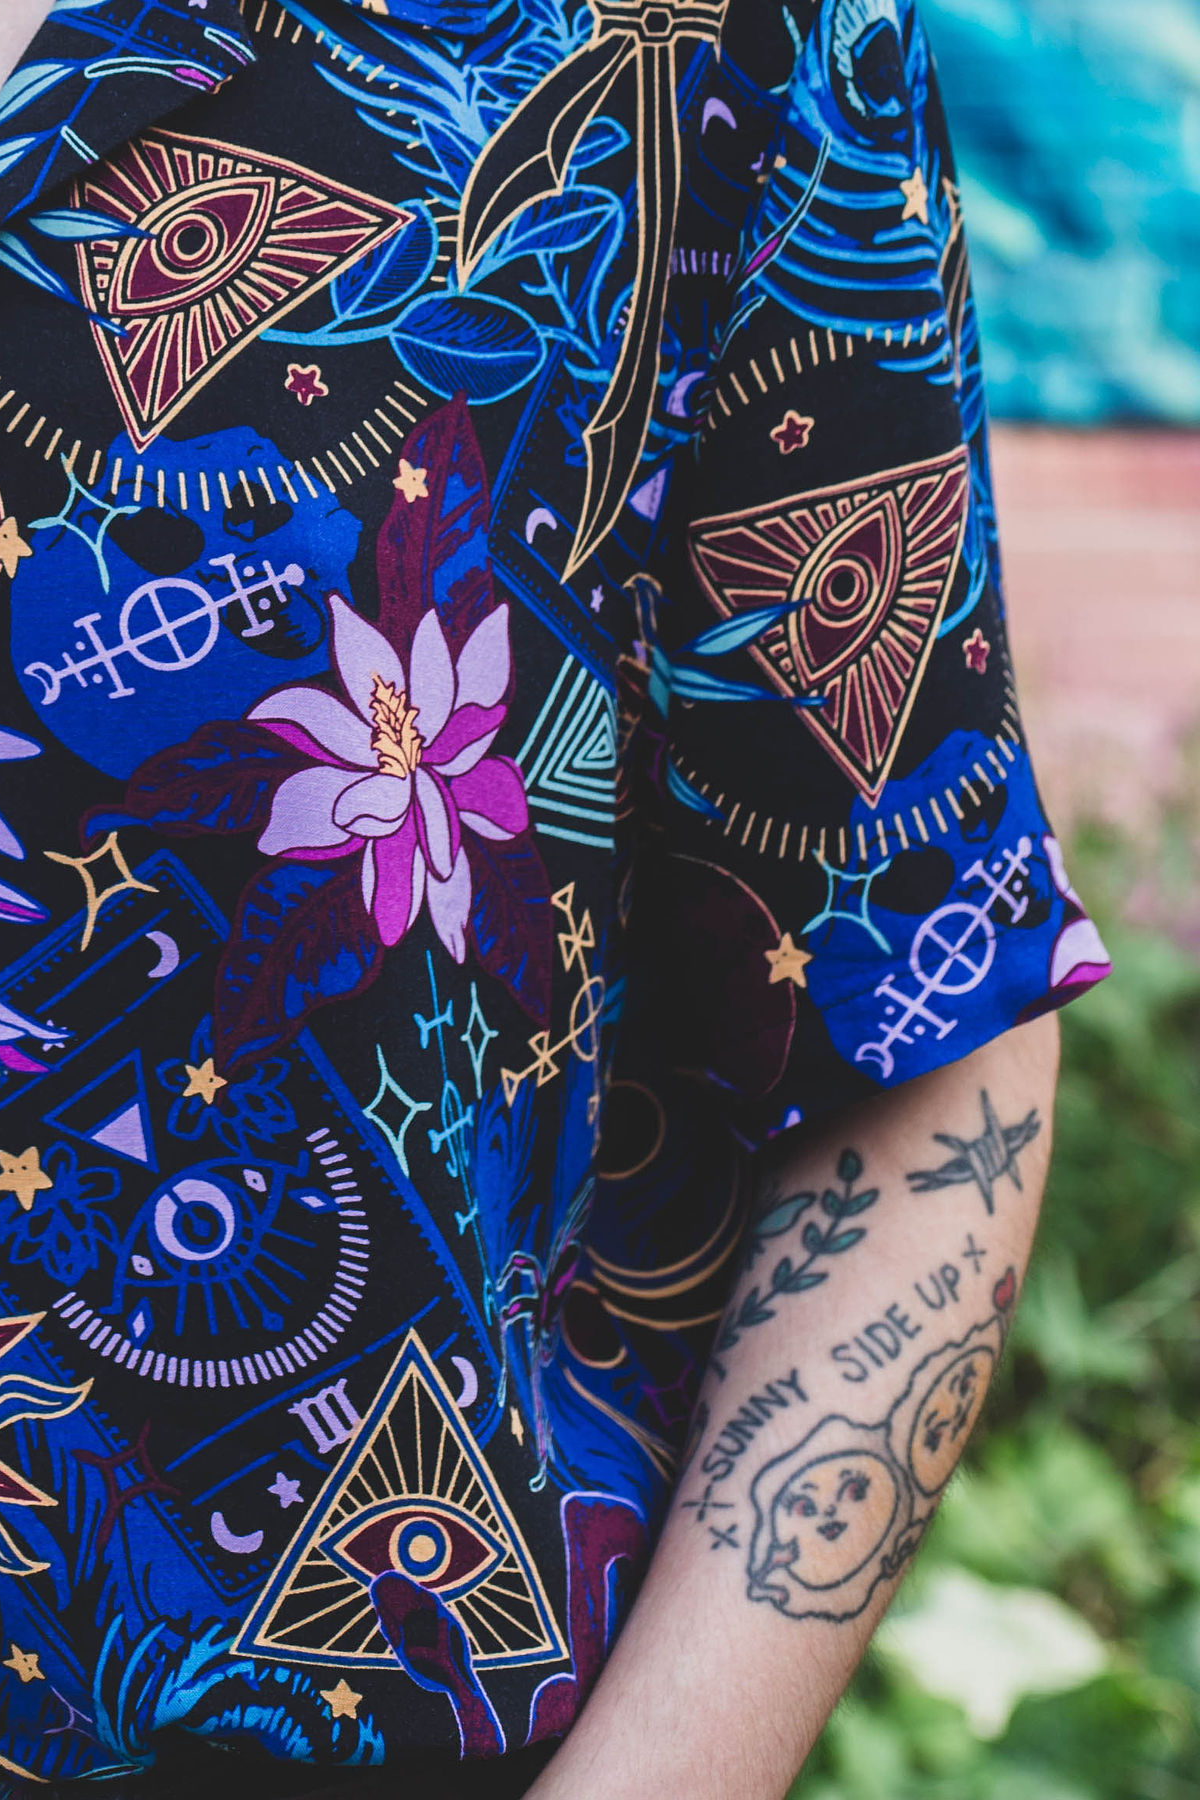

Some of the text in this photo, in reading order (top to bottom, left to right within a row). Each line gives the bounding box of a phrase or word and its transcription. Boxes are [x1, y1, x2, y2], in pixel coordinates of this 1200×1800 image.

[702, 1263, 961, 1482] SUNNY SIDE UP
